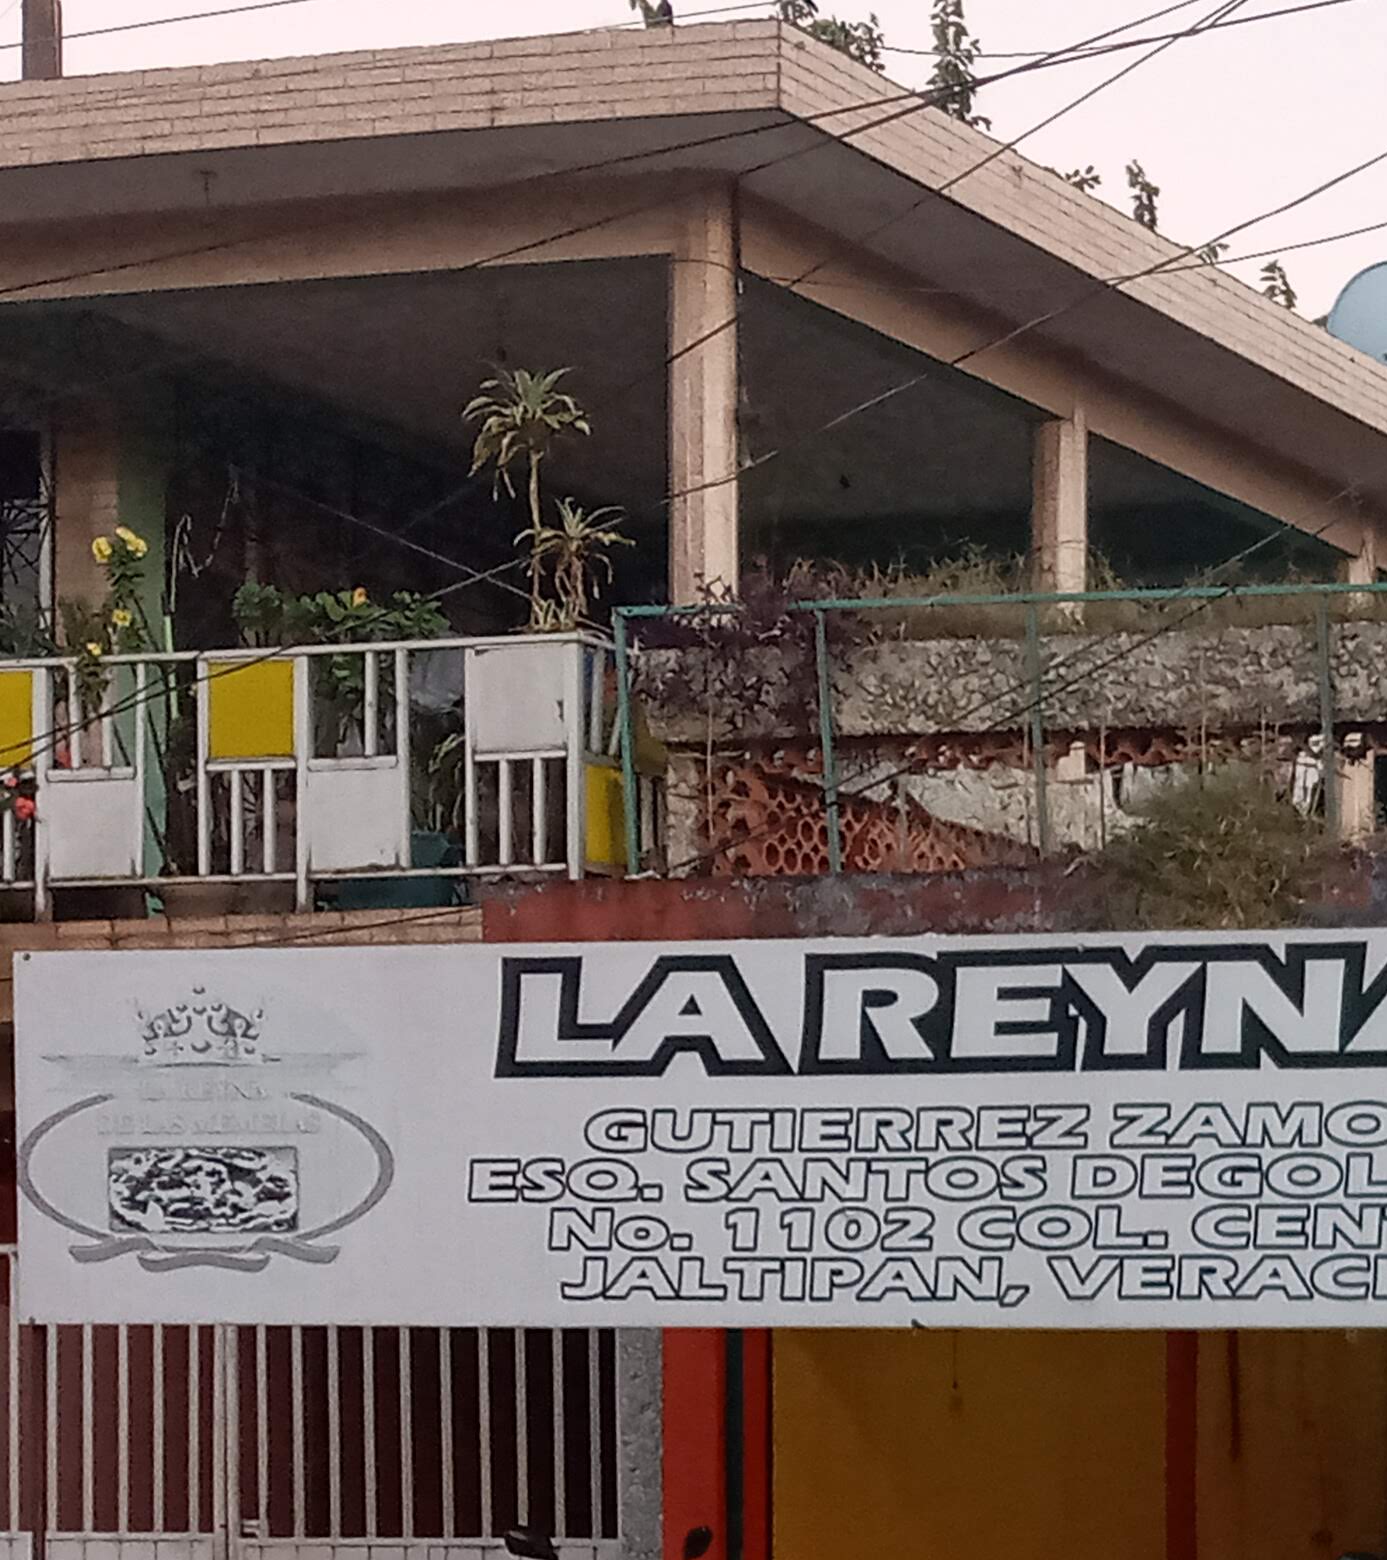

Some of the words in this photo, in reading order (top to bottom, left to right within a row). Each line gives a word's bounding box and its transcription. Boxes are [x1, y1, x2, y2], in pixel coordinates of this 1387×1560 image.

[494, 954, 797, 1078] LA
[583, 1104, 1090, 1154] GUTIERREZ
[467, 1157, 664, 1203] ESQ.
[684, 1155, 1047, 1202] SANTOS
[547, 1206, 693, 1252] No.
[724, 1206, 936, 1253] 1102
[956, 1203, 1169, 1252] COL.
[560, 1255, 1030, 1308] JALTIPAN,
